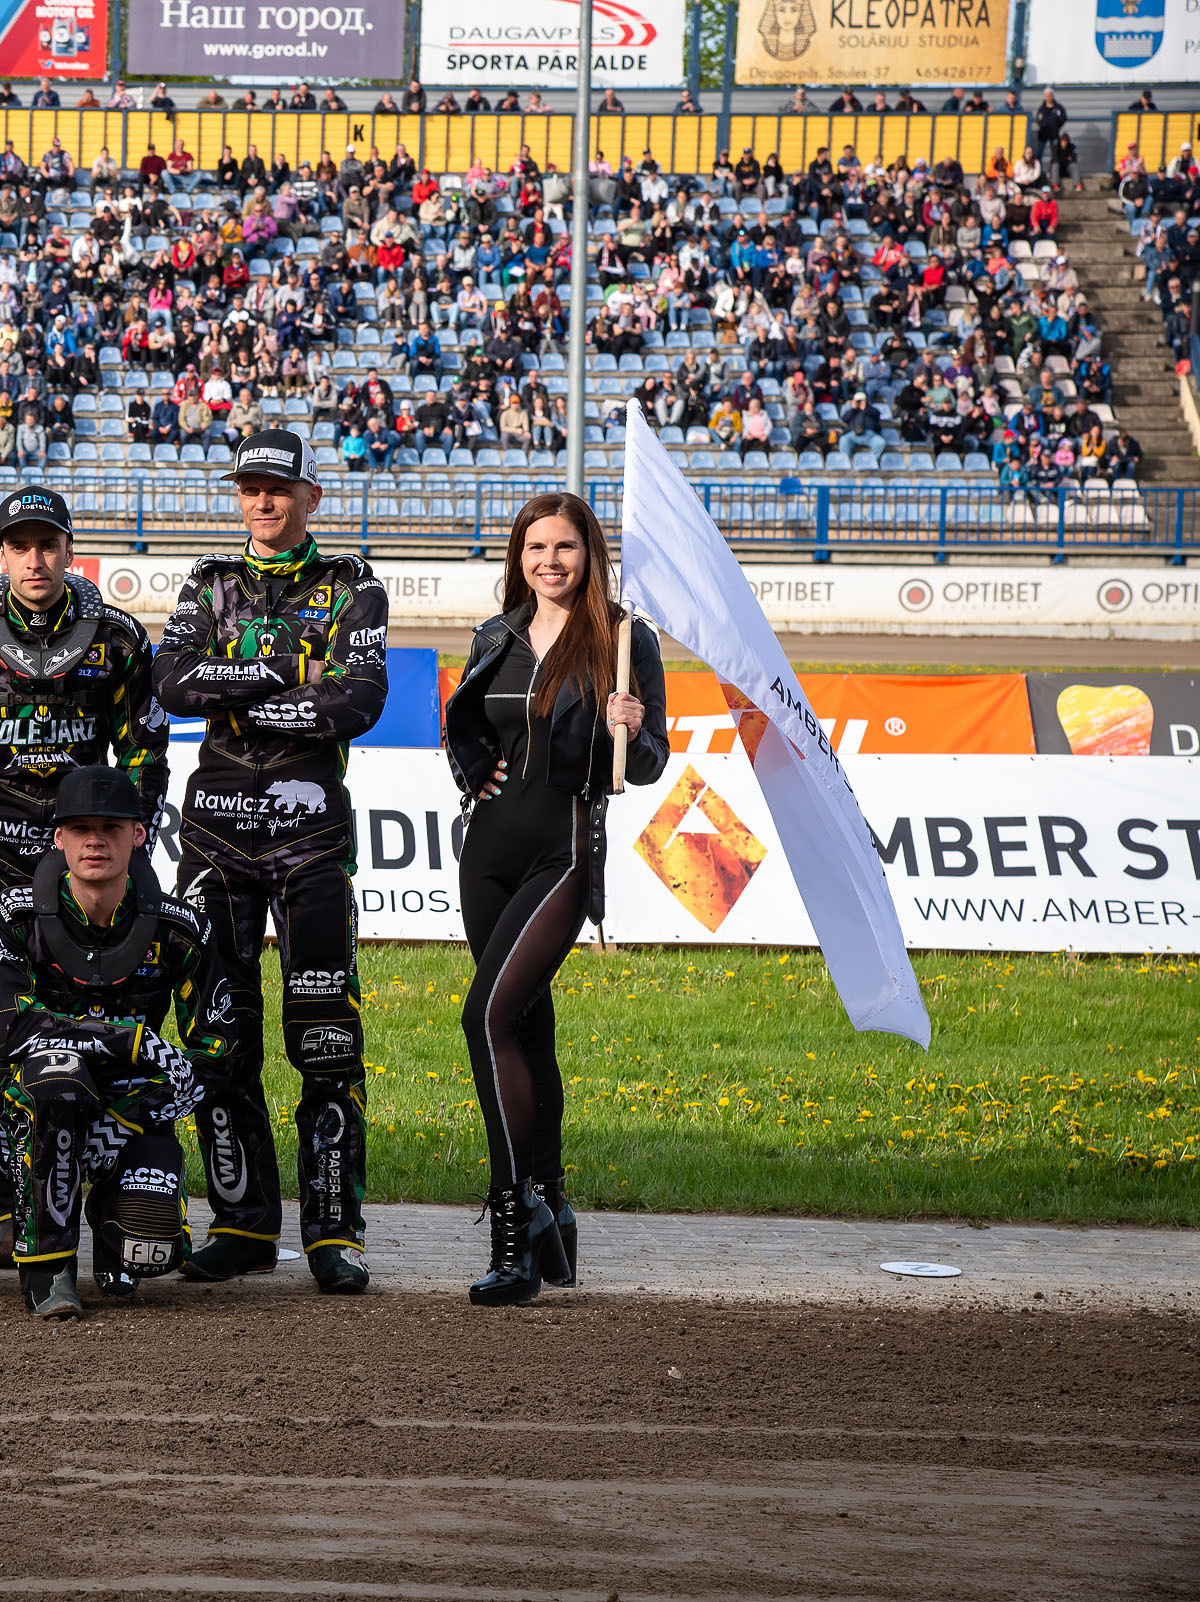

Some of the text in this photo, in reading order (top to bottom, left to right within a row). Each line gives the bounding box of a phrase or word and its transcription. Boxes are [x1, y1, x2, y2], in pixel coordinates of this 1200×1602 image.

[160, 0, 374, 37] Наш город.
[830, 0, 991, 29] KLEOPATRA
[449, 26, 616, 41] DAUGAVPIS
[918, 34, 980, 48] STUDIJA
[203, 42, 329, 59] www.gorod.lv
[447, 50, 647, 71] SPORTA PĀRALDE
[353, 123, 366, 143] K
[21, 494, 53, 506] OPV
[21, 502, 55, 514] logistic
[383, 577, 442, 597] TIBET
[942, 582, 1043, 603] OPTIBET
[1142, 582, 1200, 603] OPTI
[176, 661, 286, 684] METALIKA
[249, 700, 318, 720] ACDC
[3, 750, 82, 770] METALIKA
[193, 789, 270, 814] Rawicz
[864, 815, 1098, 879] MBER
[288, 969, 346, 987] ACDC
[9, 1031, 118, 1057] METALIKA
[211, 1106, 236, 1185] WIKO
[56, 1129, 73, 1208] WIKO
[120, 1167, 178, 1189] ACDC
